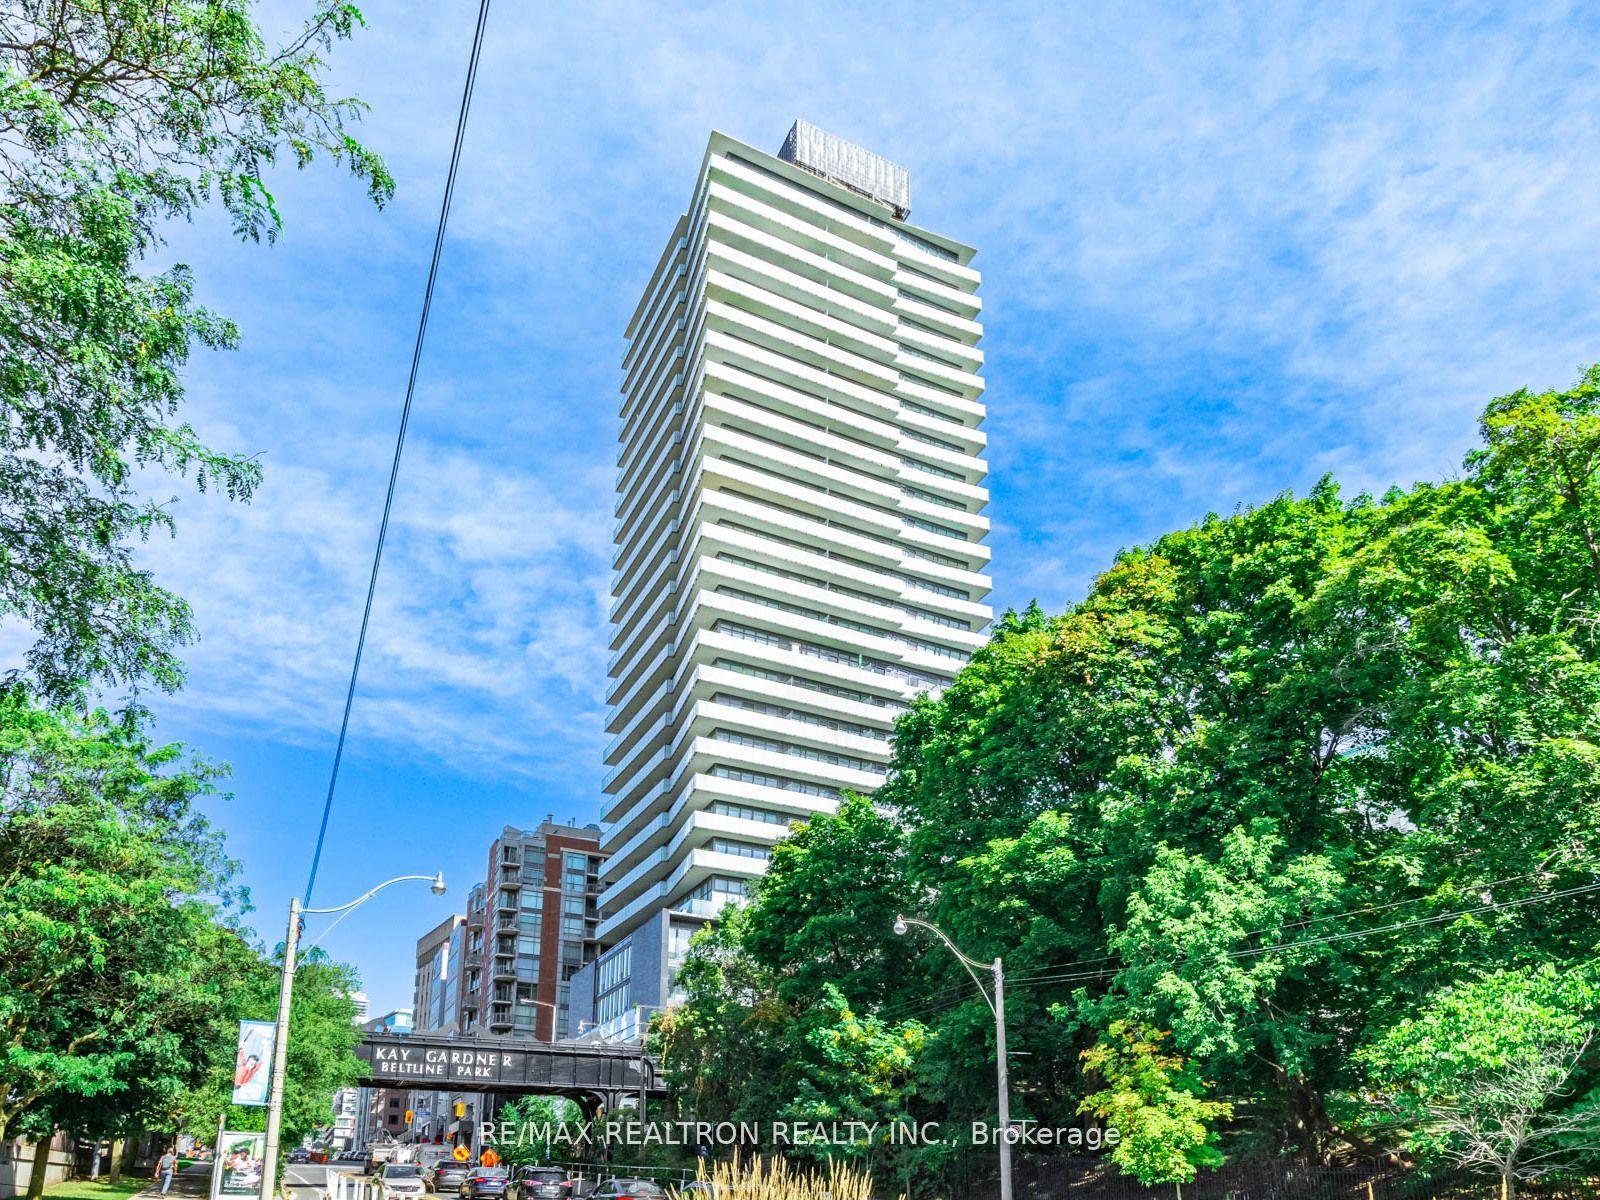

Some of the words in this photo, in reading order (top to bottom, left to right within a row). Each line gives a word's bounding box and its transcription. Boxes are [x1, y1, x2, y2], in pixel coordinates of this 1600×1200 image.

[376, 1048, 410, 1061] KAY
[381, 1062, 443, 1075] BELTLINE
[457, 1066, 491, 1077] PARK
